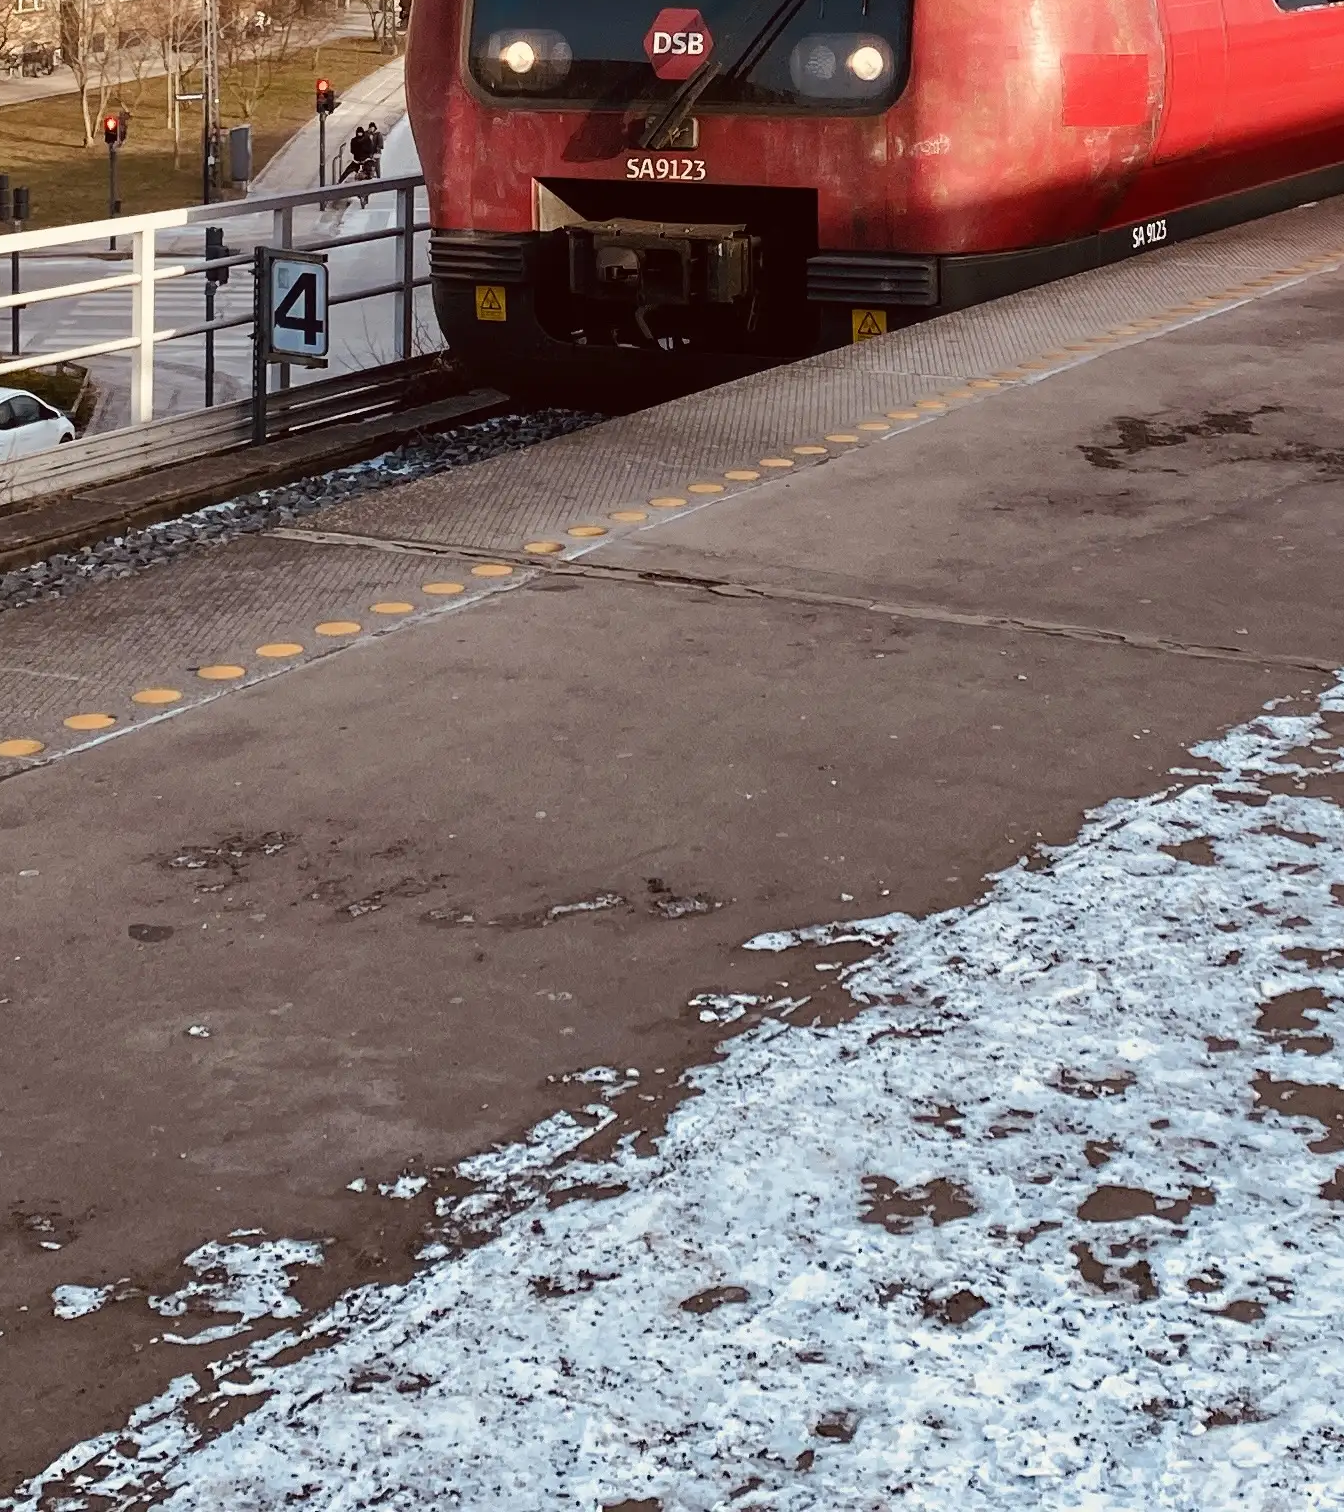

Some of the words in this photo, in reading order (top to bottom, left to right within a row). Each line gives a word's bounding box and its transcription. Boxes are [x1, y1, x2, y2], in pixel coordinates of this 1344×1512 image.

[653, 31, 704, 55] DSB
[626, 157, 706, 181] SA9123
[1132, 226, 1146, 248] SA
[1146, 219, 1167, 244] 9123
[274, 272, 324, 346] 4
